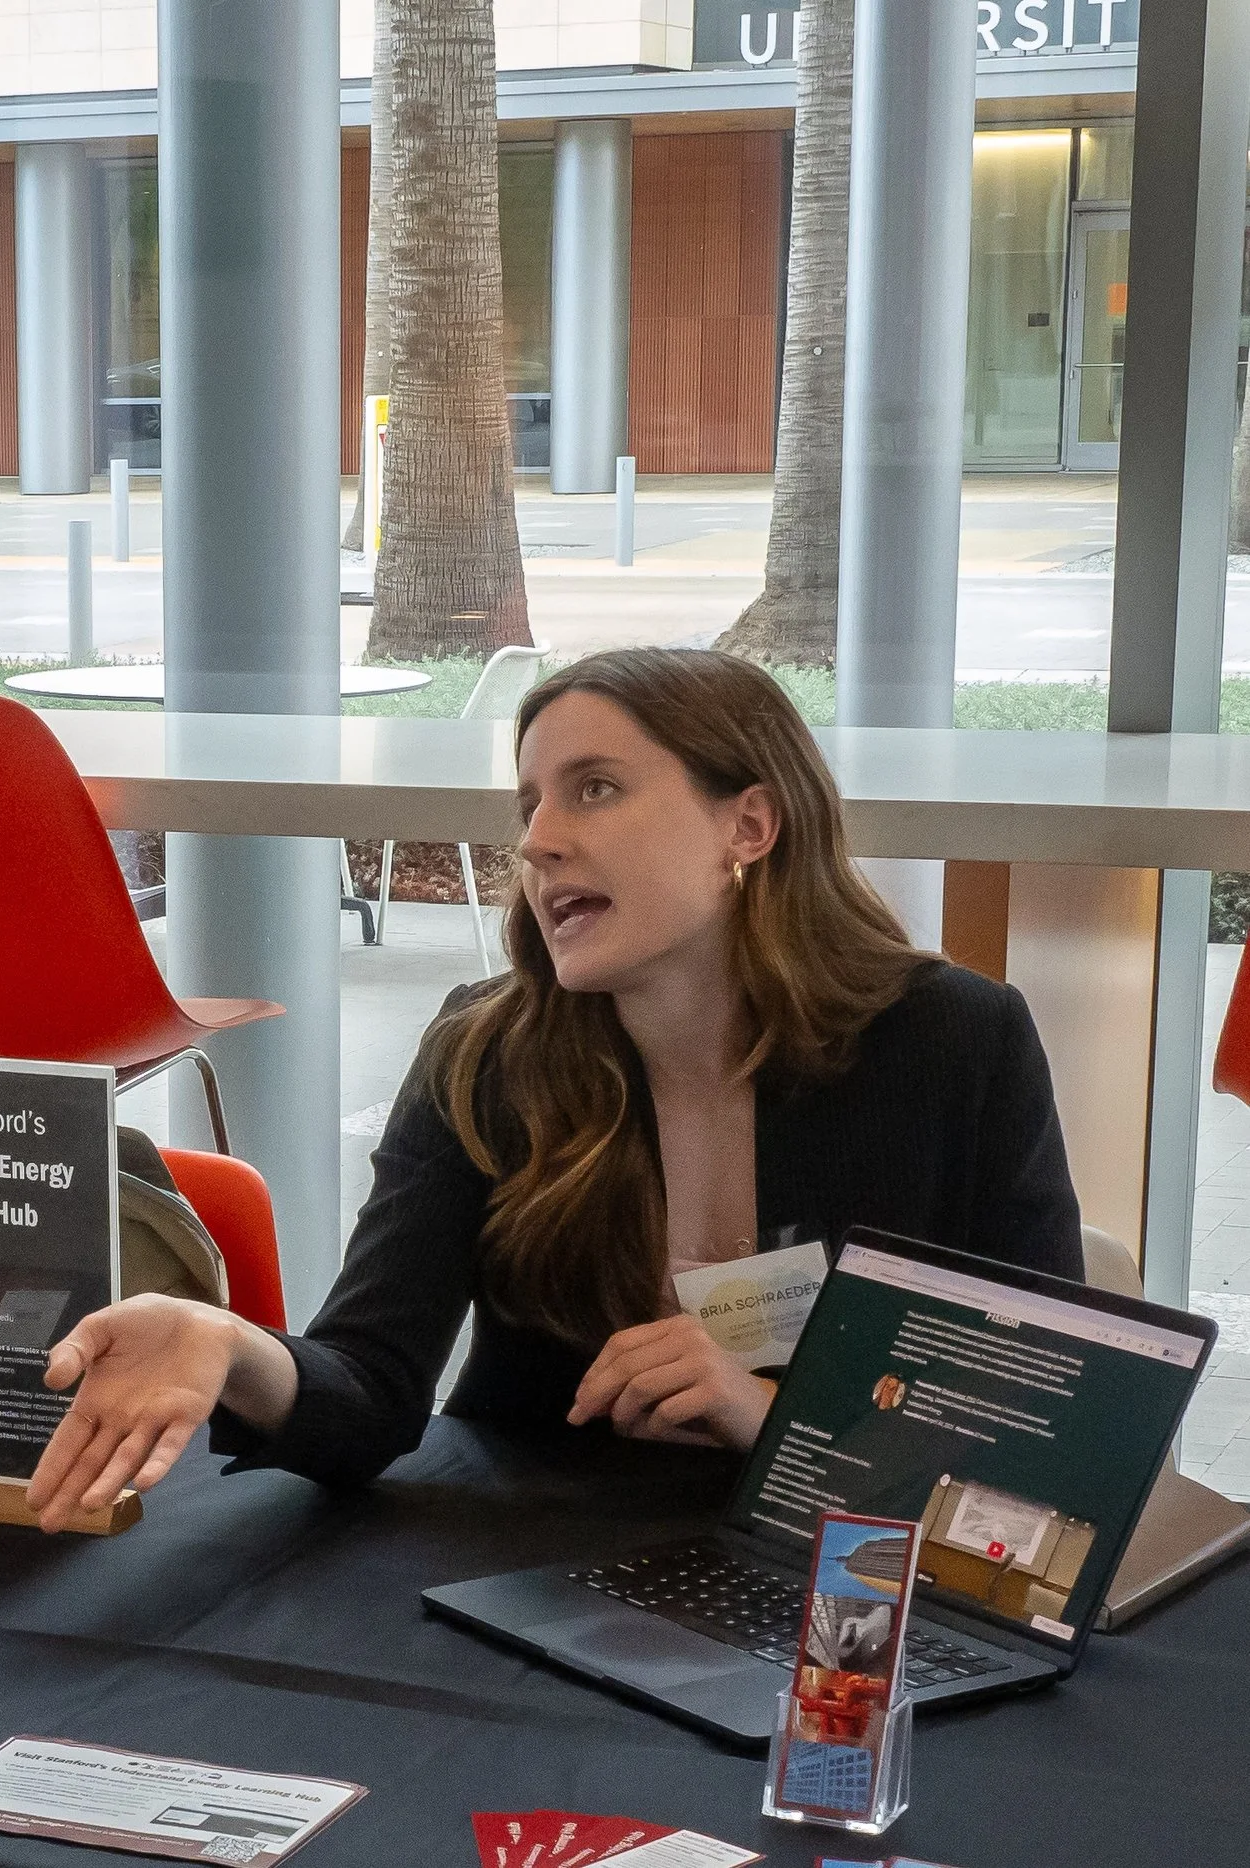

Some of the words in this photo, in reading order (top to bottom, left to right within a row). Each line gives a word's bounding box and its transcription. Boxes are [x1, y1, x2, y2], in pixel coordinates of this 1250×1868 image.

[700, 1302, 733, 1319] BRIA
[13, 1751, 42, 1761] Visit
[111, 1765, 187, 1782] Understand
[187, 1778, 231, 1790] Energy
[234, 1784, 293, 1798] Learning
[294, 1793, 322, 1803] Hub
